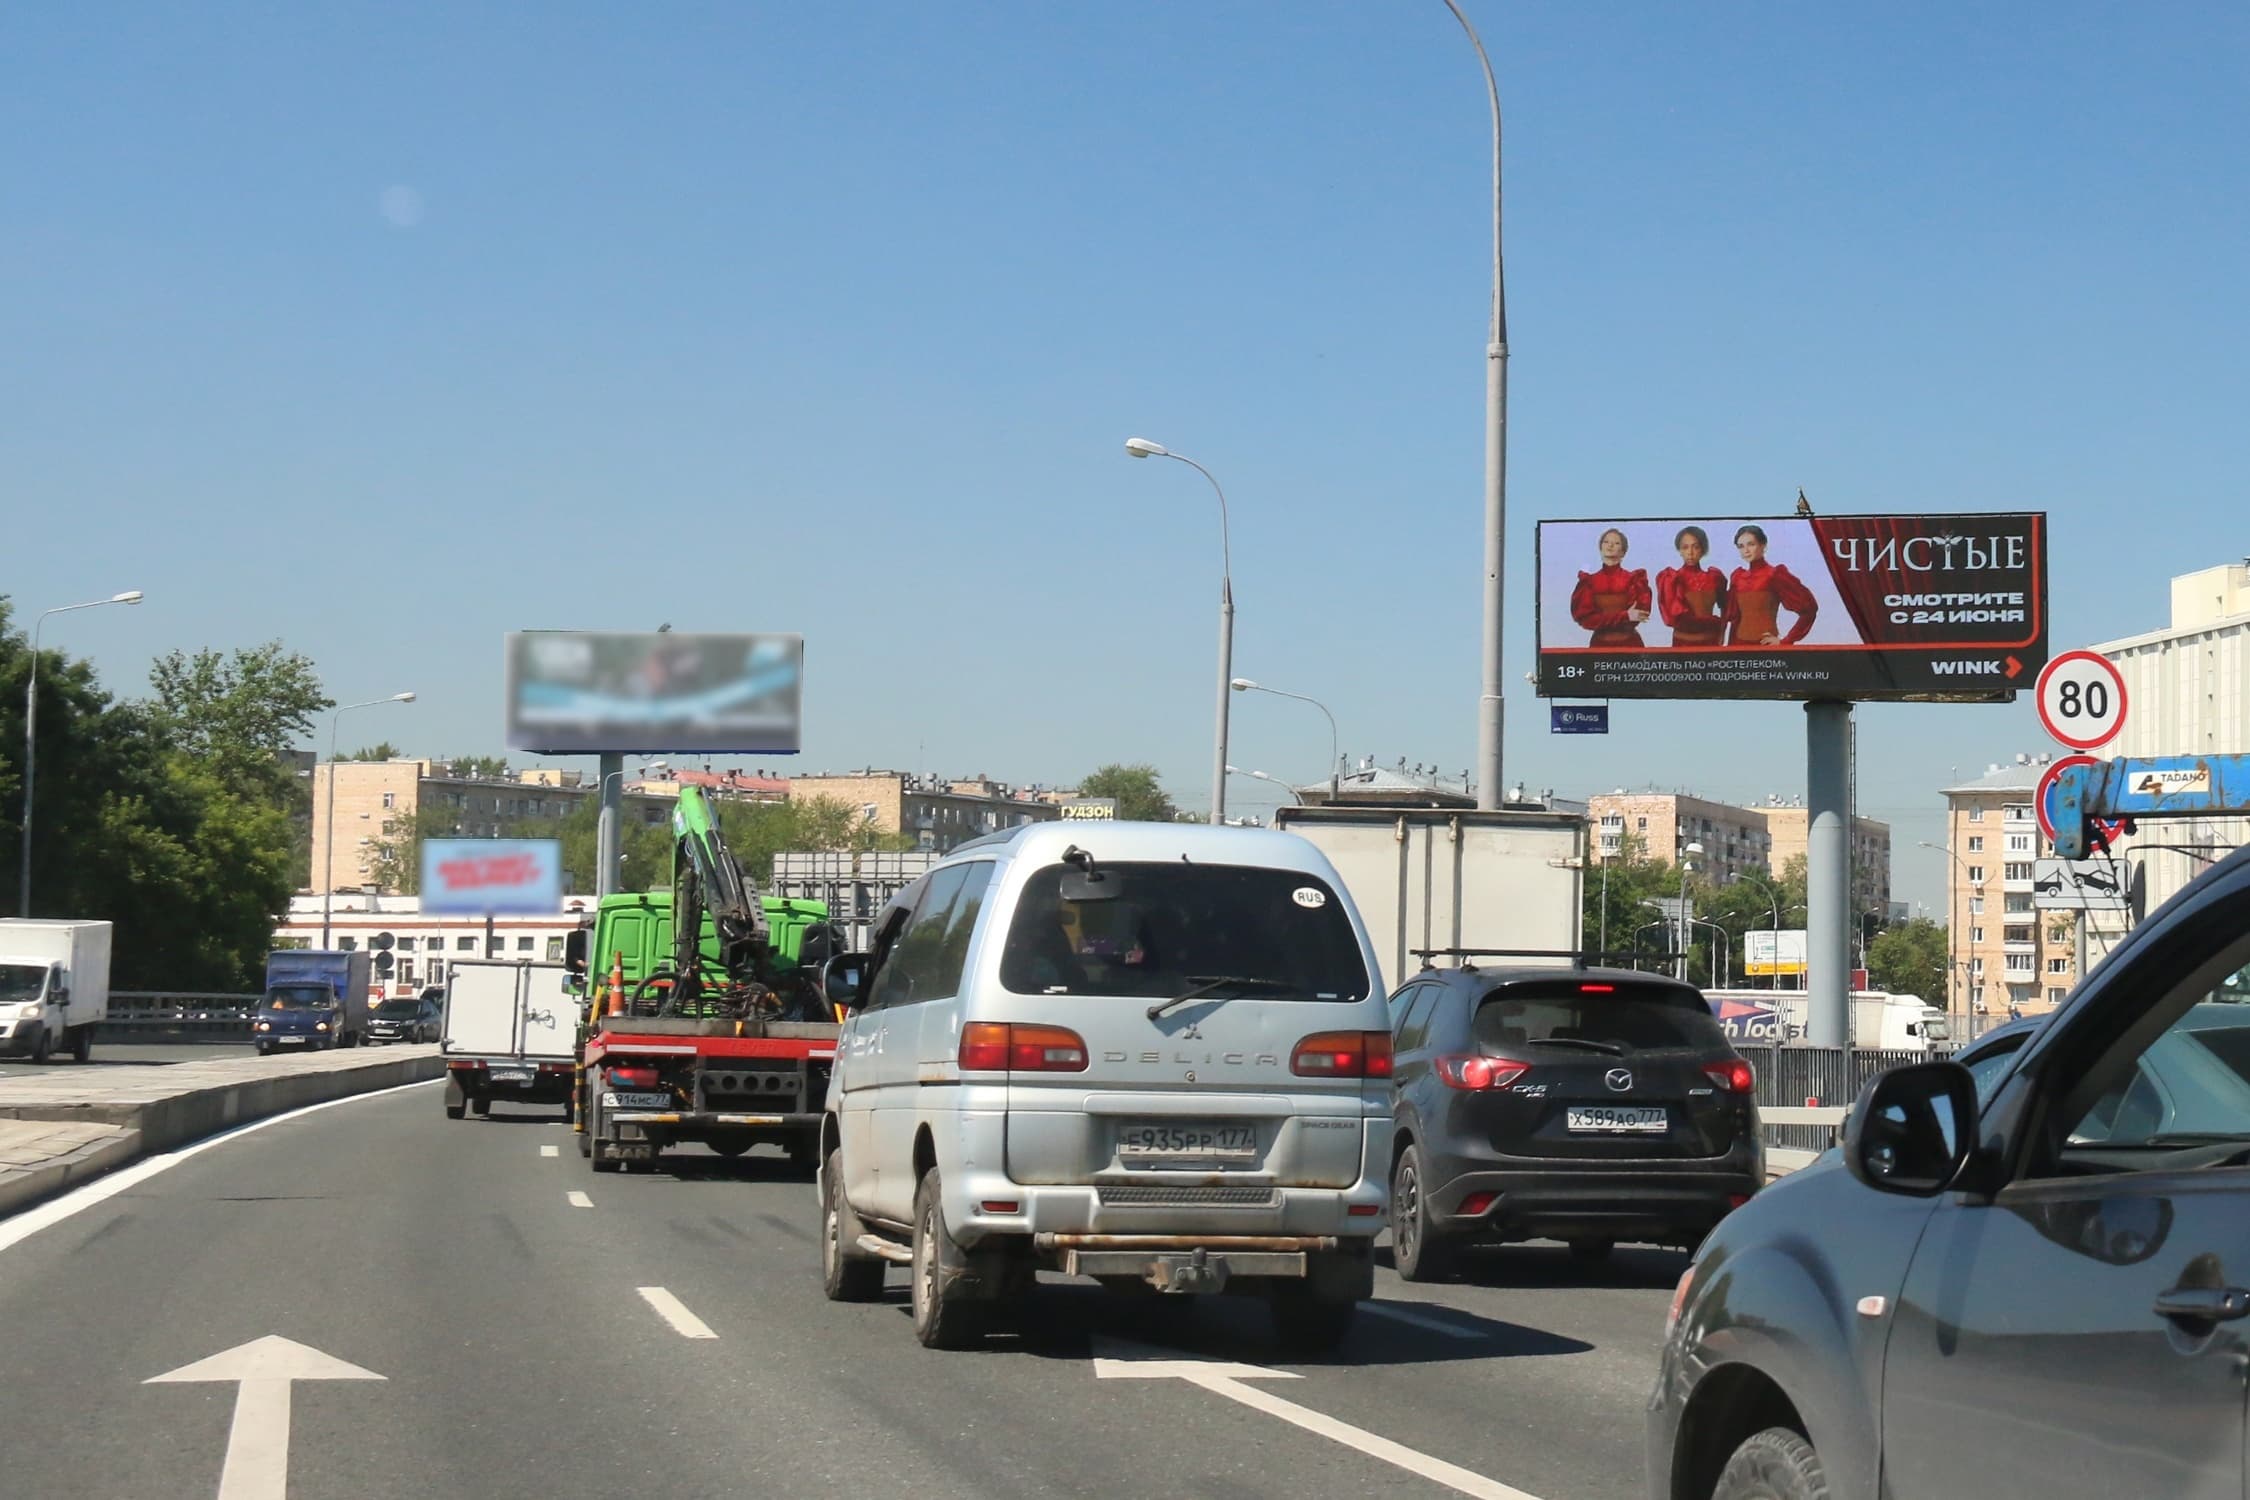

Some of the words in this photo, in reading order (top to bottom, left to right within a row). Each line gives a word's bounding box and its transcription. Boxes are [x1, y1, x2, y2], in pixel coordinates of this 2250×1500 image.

[1832, 533, 2025, 572] ЧИСТЫЕ
[1884, 592, 2025, 607] СМОТРИТЕ
[1890, 612, 1909, 624] С
[1912, 611, 1946, 624] 24
[1949, 609, 2025, 623] ИЮНЯ
[1557, 666, 1586, 679] 18+
[1593, 660, 1682, 671] РЕКЛАМОДАТЕЛЬ
[1684, 660, 1706, 670] ПАО
[1930, 659, 2002, 675] WINK
[1593, 673, 1621, 682] ОГРН
[1705, 671, 1768, 682] ПОДРОБНЕЕ
[1769, 671, 1784, 681] НА
[1785, 670, 1830, 681] WINK.RU
[2058, 680, 2109, 719] 80
[2160, 772, 2207, 783] TADANO
[1060, 805, 1114, 818] ГУДЗОН
[1297, 891, 1323, 904] RUS
[1103, 1051, 1279, 1067] DELICA
